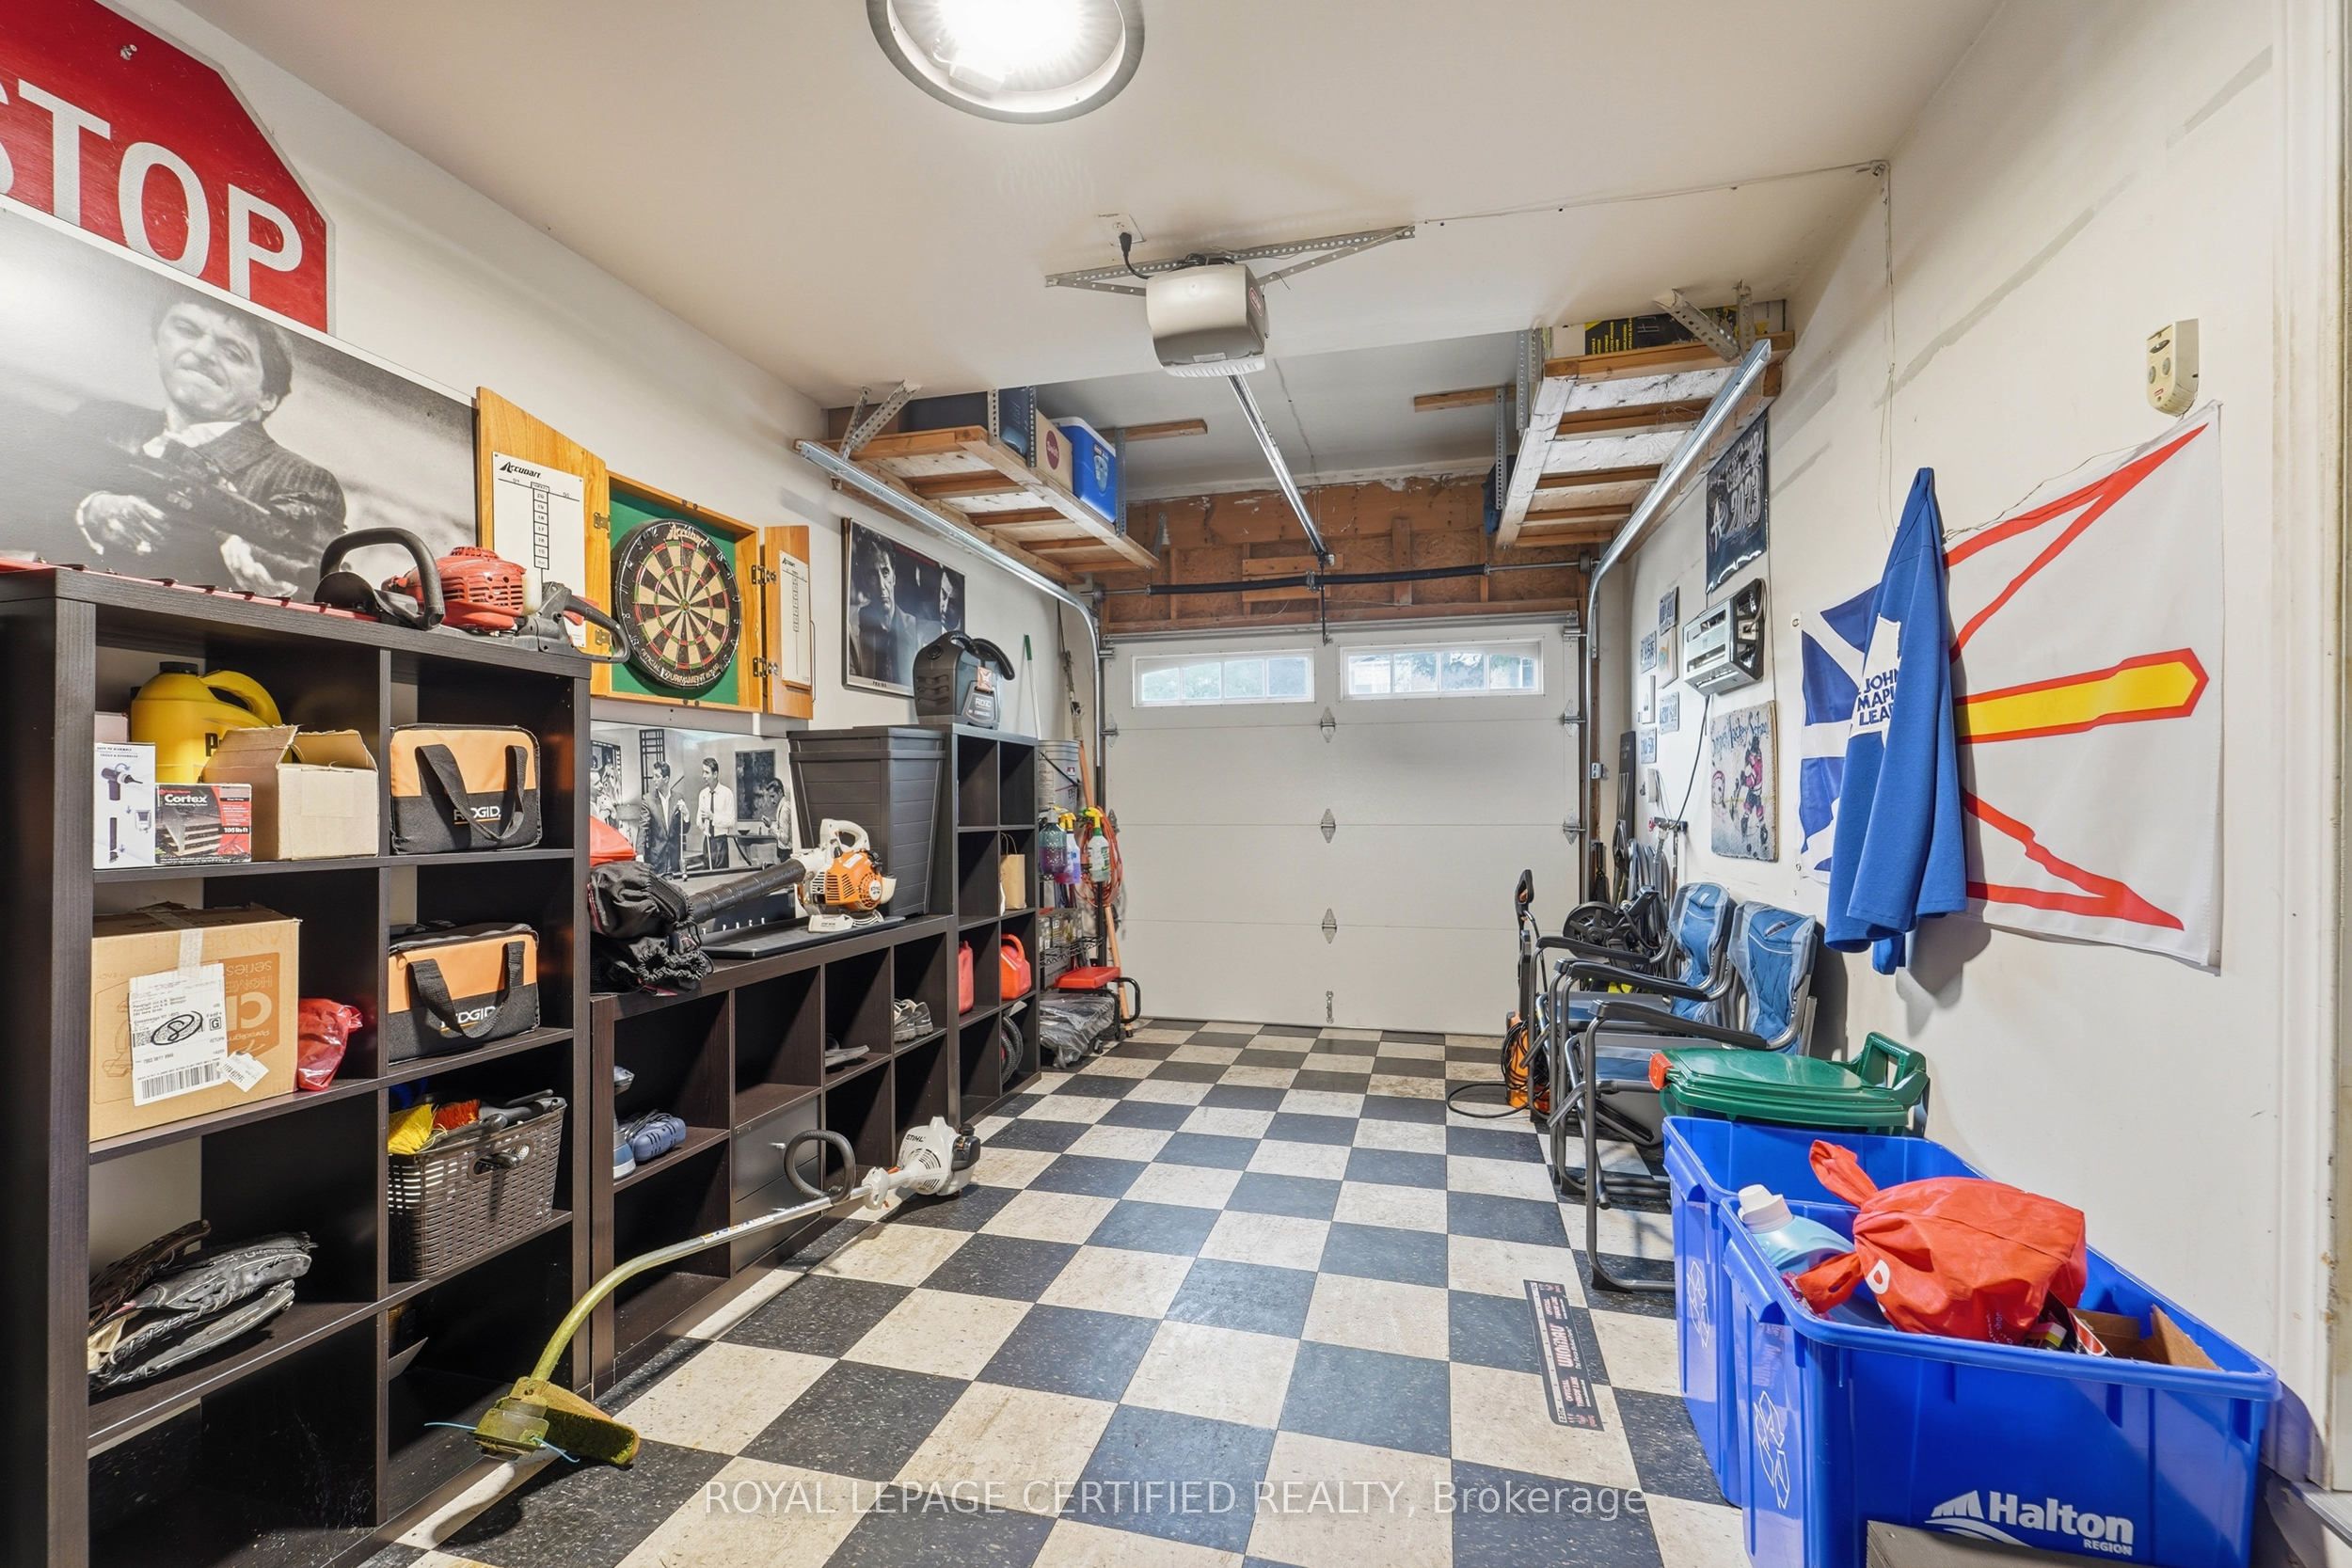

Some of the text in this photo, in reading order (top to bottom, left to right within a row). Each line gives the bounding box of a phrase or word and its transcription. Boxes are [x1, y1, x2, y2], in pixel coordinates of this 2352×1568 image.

[0, 78, 303, 301] TOP
[165, 794, 207, 803] Cortex
[226, 960, 272, 976] series
[211, 1019, 220, 1029] G
[441, 1006, 497, 1028] DGID
[906, 1133, 925, 1143] STIHL
[1989, 1490, 2134, 1544] Halton
[2083, 1539, 2134, 1556] REGION
